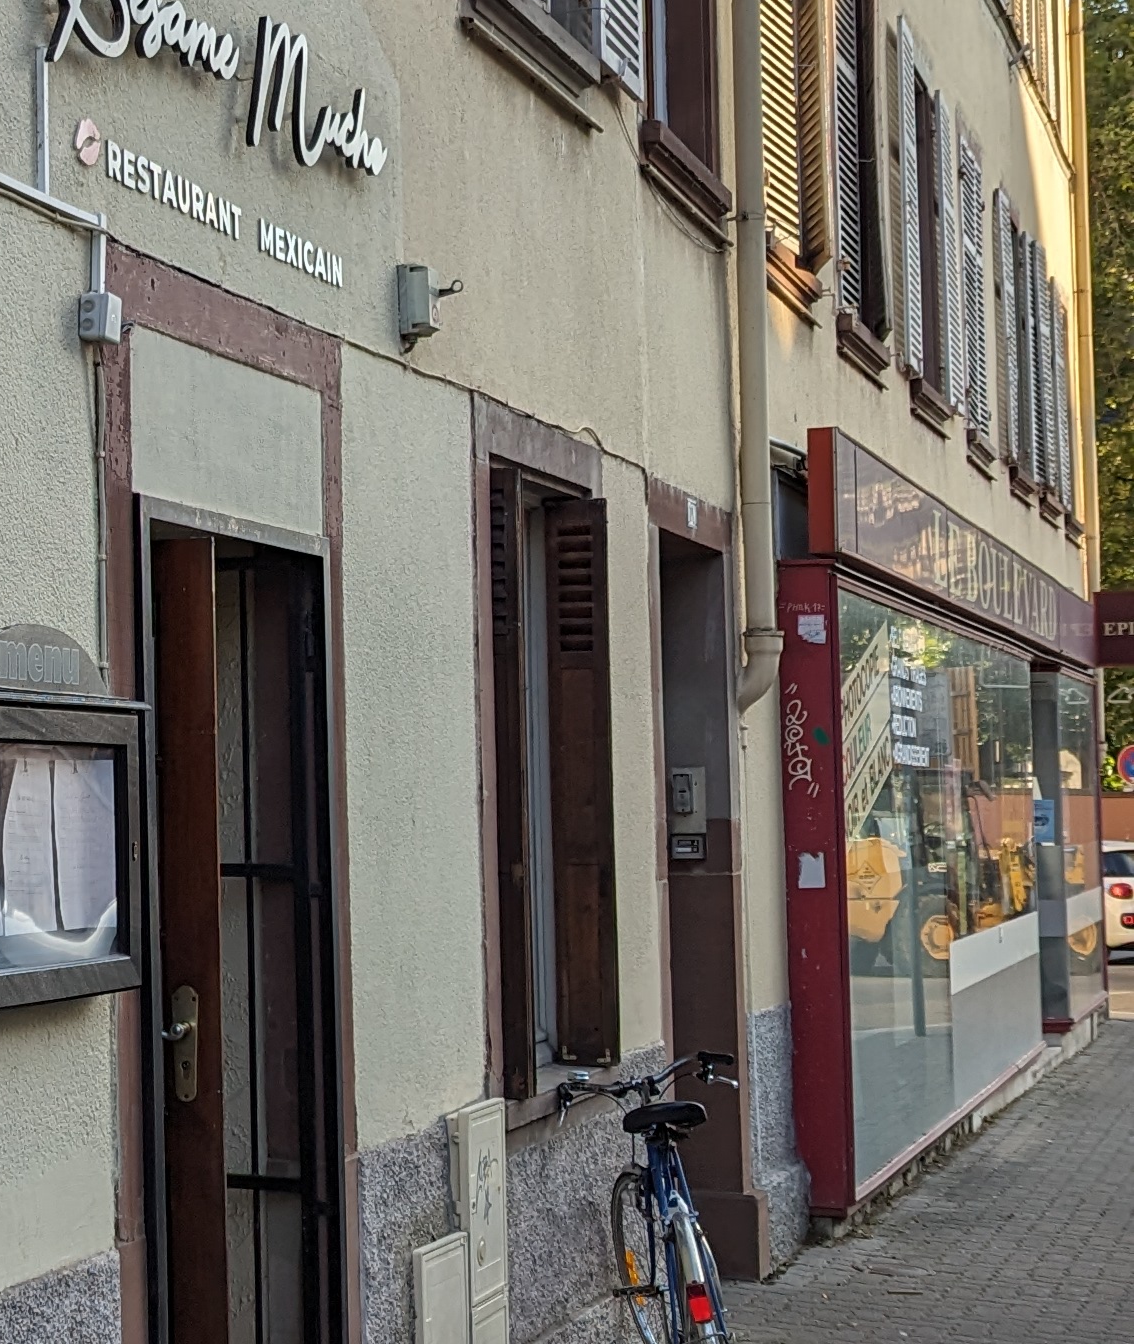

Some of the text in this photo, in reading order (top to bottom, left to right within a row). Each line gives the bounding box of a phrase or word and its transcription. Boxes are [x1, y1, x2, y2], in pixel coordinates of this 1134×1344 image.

[246, 15, 388, 176] Mucho
[106, 140, 343, 288] RESTAURANT MEXICAIN
[933, 509, 1057, 642] LE BOULEVARD
